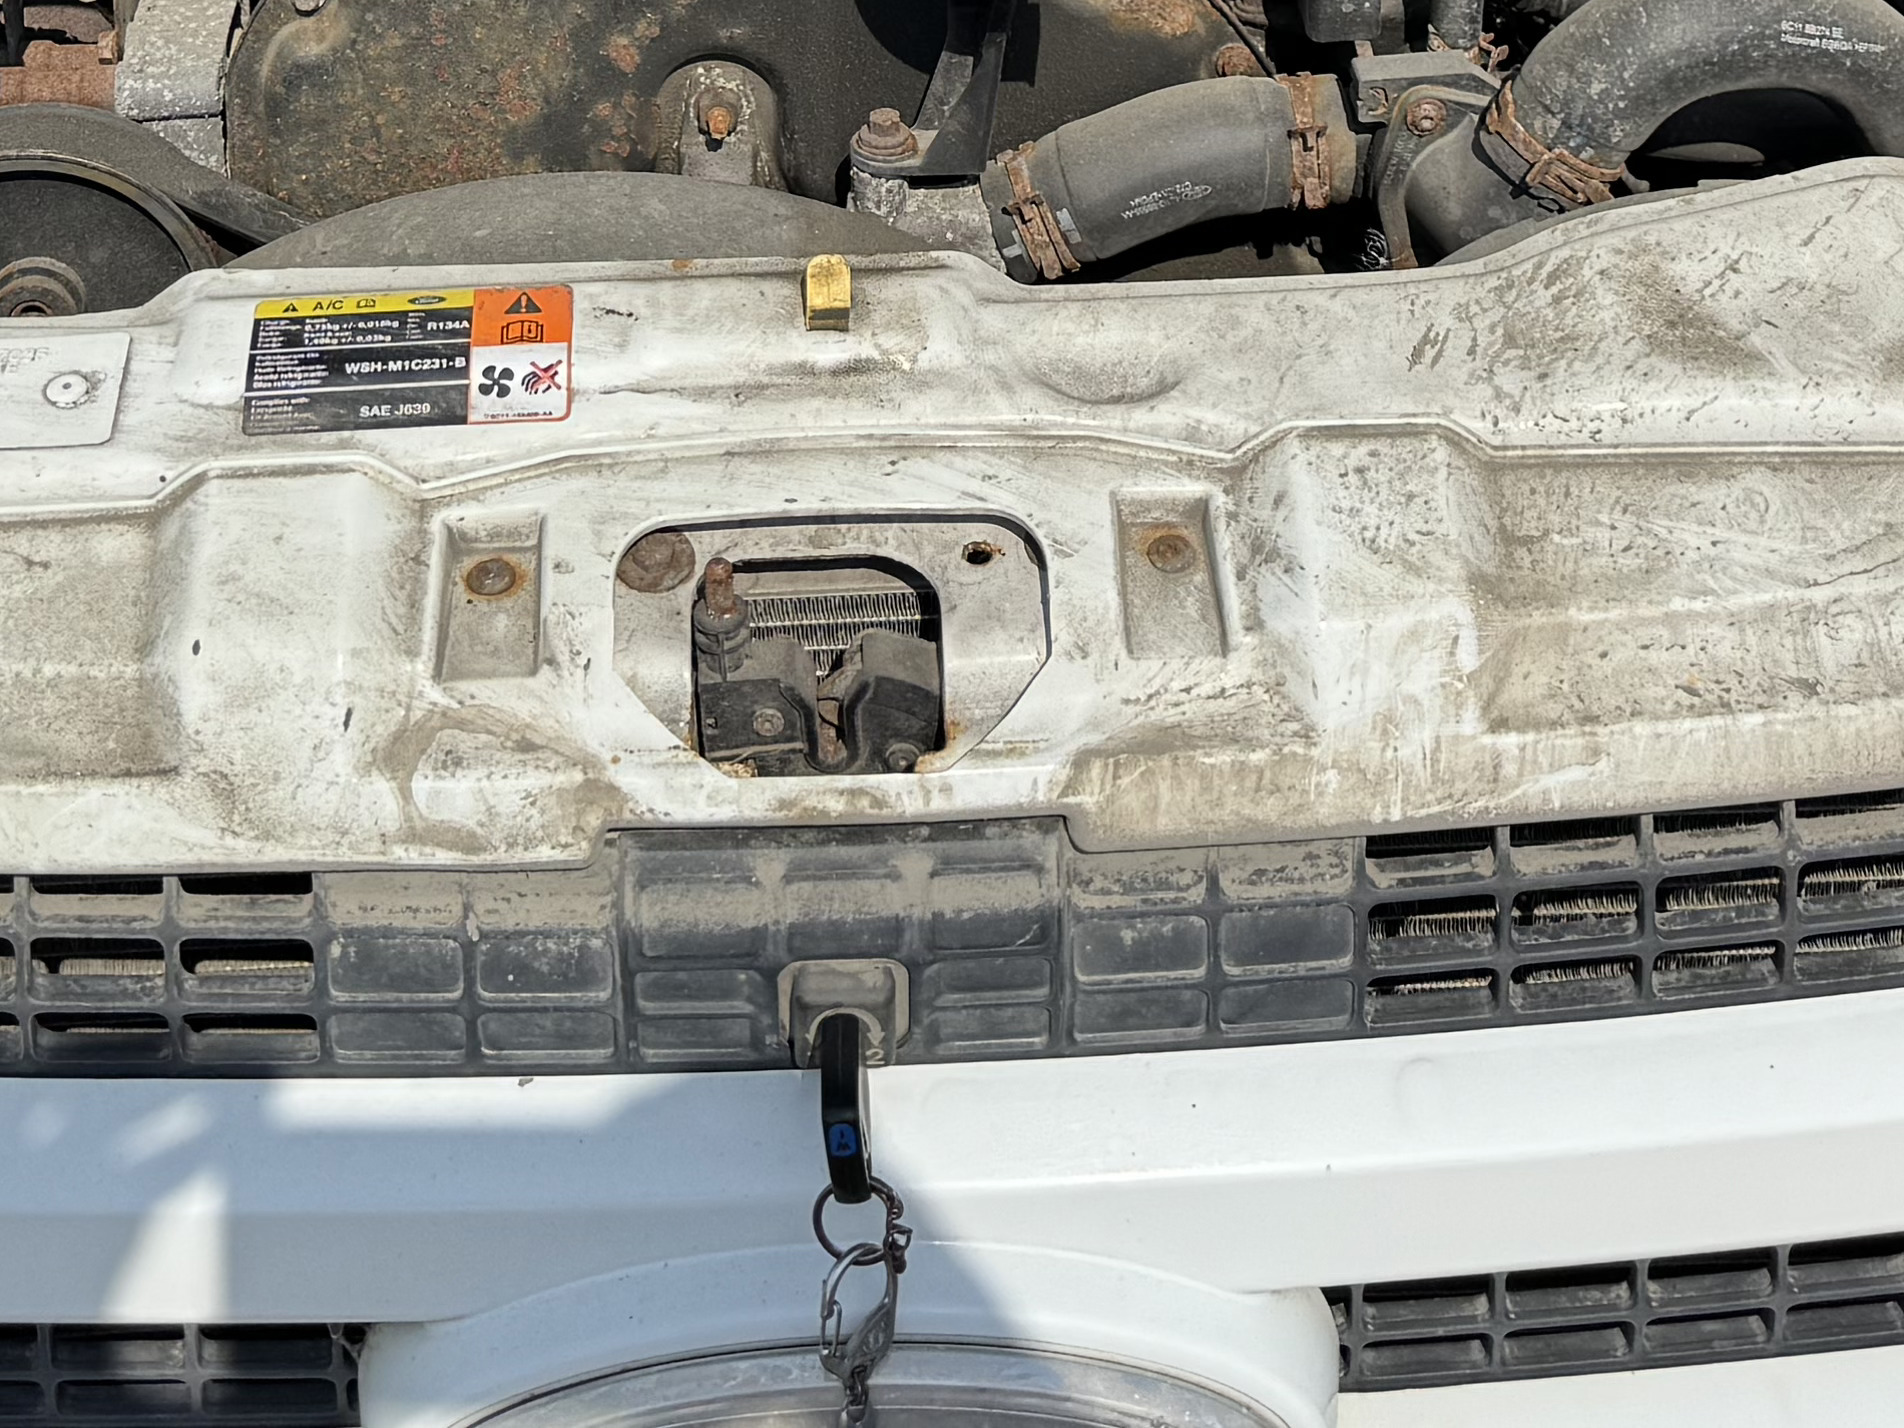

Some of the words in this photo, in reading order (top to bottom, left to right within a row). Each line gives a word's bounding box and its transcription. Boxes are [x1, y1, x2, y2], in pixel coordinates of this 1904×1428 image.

[312, 299, 344, 312] A/C
[426, 319, 471, 332] R134A
[359, 404, 391, 418] SAE
[865, 1048, 886, 1065] 2
